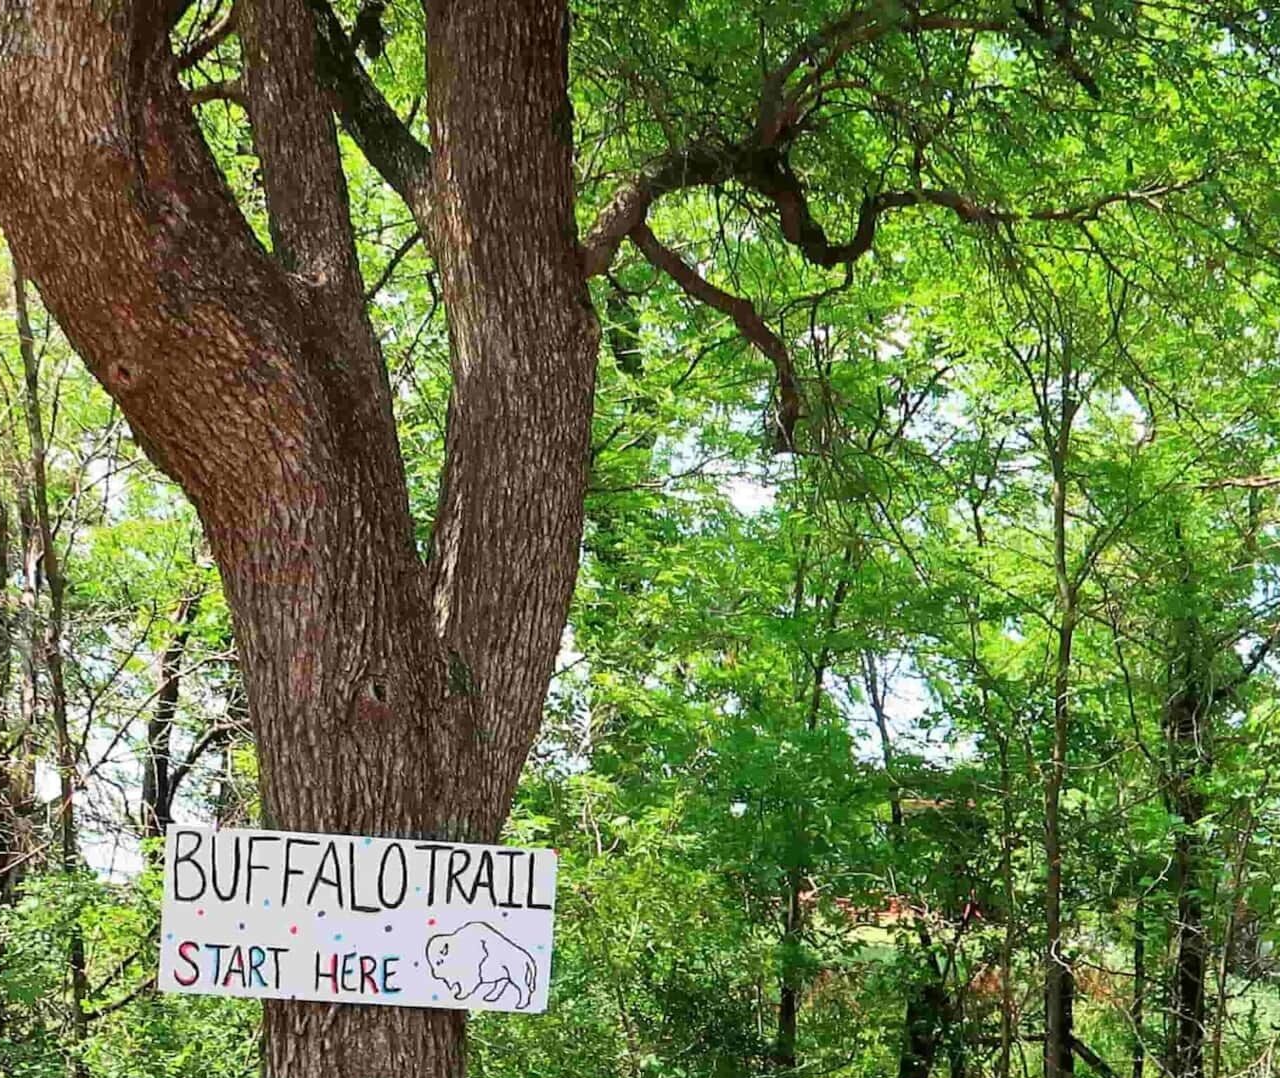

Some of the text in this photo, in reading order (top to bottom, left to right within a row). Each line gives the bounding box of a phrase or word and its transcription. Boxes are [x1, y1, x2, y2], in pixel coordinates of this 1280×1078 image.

[173, 830, 552, 913] BUFFALO TRAIL
[173, 941, 402, 994] START HERE
